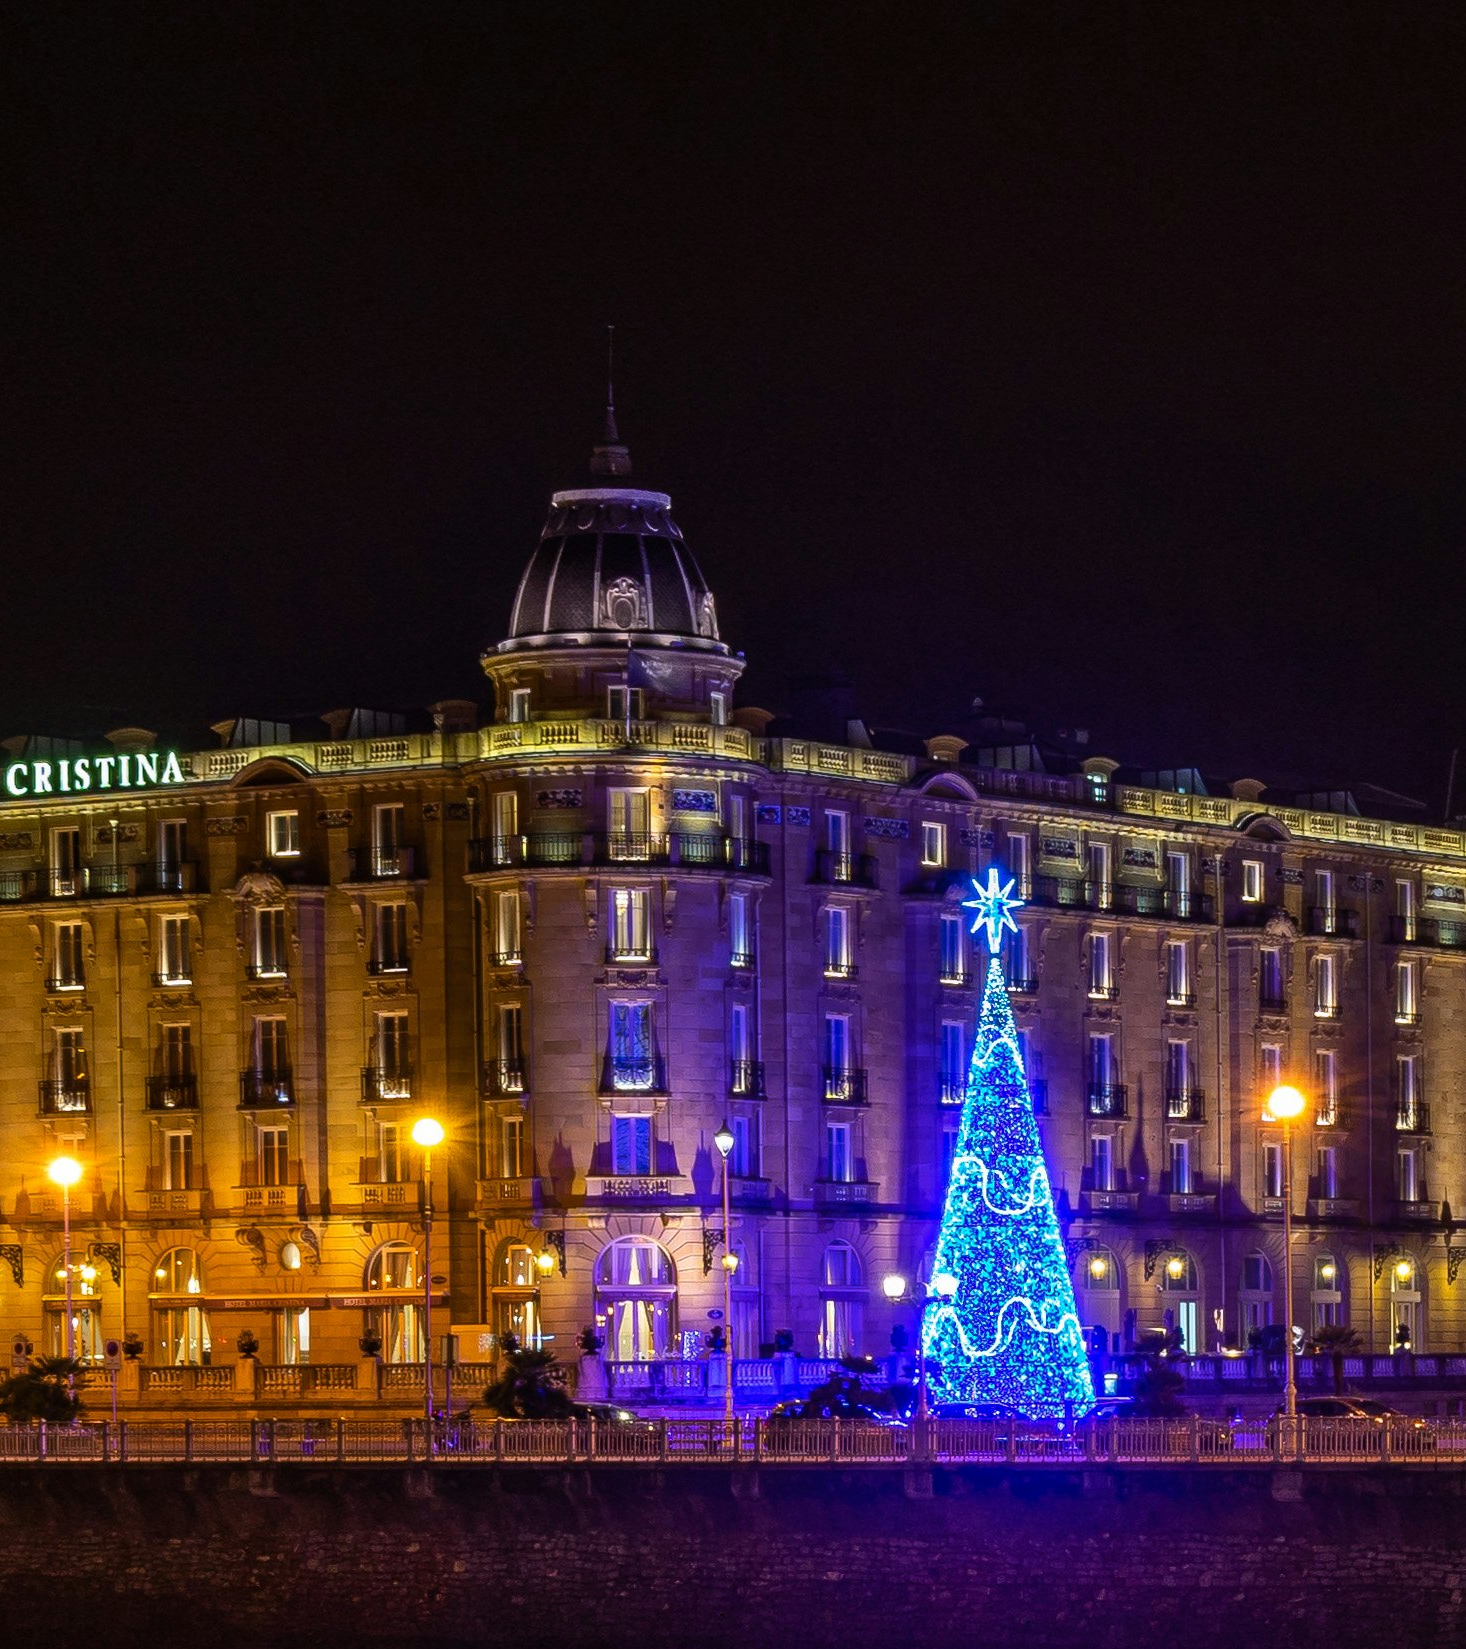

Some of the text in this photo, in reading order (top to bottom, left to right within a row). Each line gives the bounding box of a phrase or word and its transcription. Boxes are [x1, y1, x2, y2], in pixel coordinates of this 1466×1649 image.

[6, 751, 185, 796] CRISTINA
[224, 1300, 247, 1308] HOTEL
[343, 1298, 367, 1306] HOTEL
